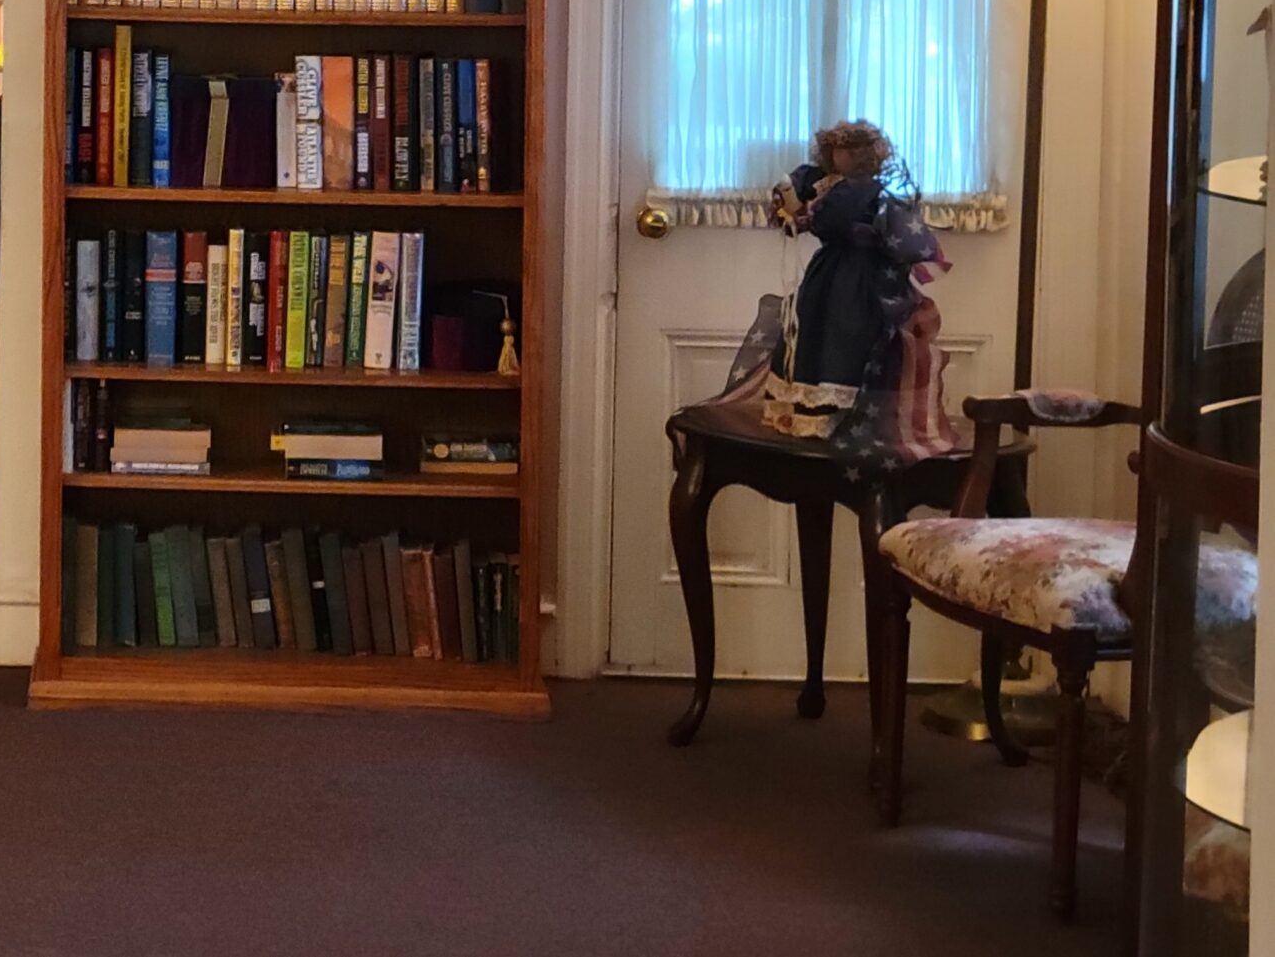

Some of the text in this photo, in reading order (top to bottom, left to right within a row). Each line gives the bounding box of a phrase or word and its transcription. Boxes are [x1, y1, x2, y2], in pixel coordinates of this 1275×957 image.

[296, 61, 307, 116] CUSSLER
[307, 69, 317, 107] CLIVE
[443, 72, 452, 94] CLIVE
[478, 80, 487, 155] HARRY POTTER
[298, 134, 306, 172] FOUND
[307, 127, 317, 180] ATLANTIS
[395, 136, 409, 162] BLOW
[395, 163, 409, 182] FLY
